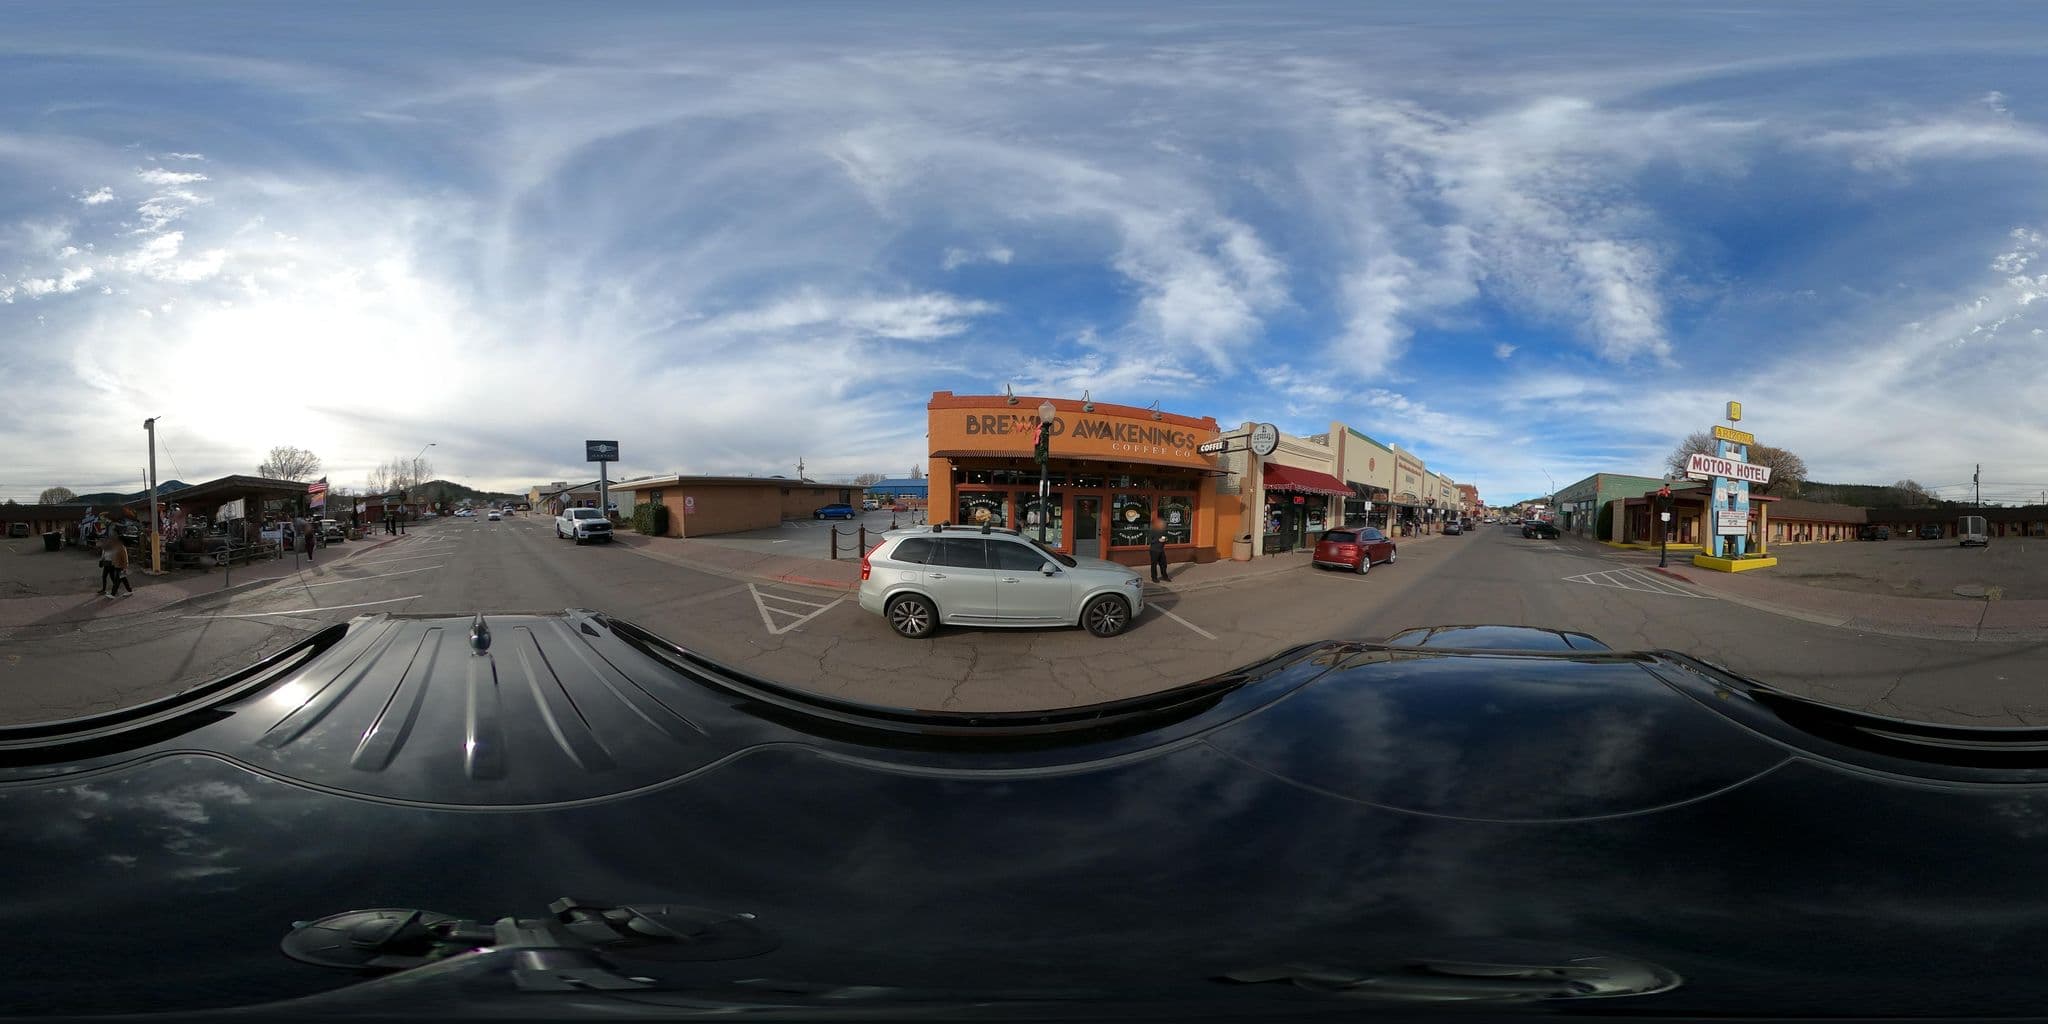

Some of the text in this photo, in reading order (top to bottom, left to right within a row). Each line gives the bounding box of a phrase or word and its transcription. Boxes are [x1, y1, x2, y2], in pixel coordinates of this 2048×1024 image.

[966, 414, 1195, 450] BREWD AWAKENINGS
[1717, 428, 1753, 444] ARIZONA
[1112, 442, 1190, 457] COFFEE CO
[1200, 442, 1223, 452] COFFEE
[1692, 456, 1767, 481] MOTOR HOTEL
